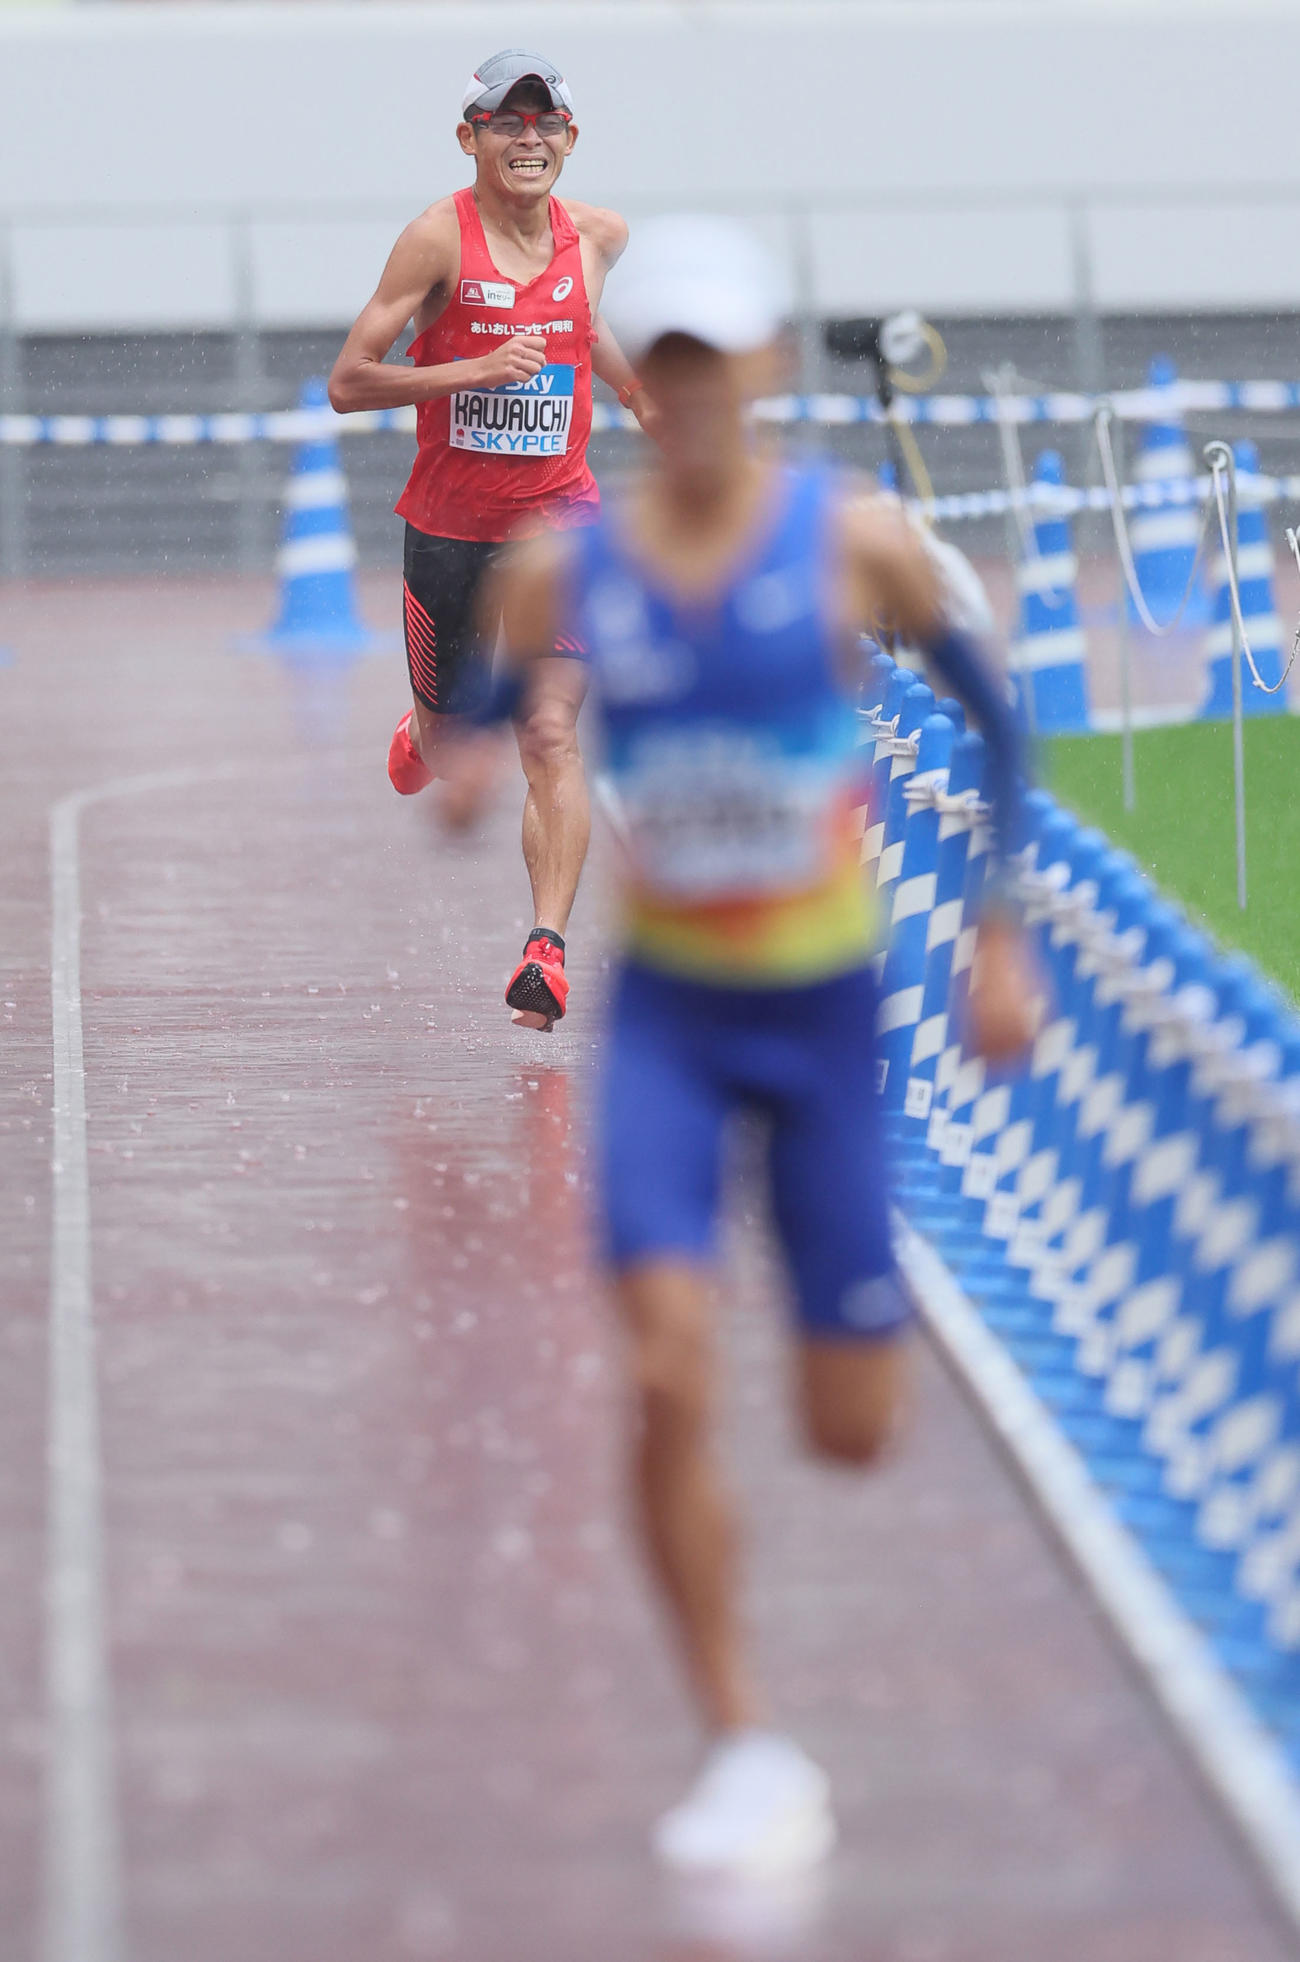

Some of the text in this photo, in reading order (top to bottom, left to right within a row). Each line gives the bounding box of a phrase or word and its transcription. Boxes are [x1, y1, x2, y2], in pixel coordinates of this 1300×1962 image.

[470, 320, 573, 336] あいおいニッセイ同和
[455, 393, 568, 432] KAWAUCHI
[471, 430, 563, 452] SKYPCE
